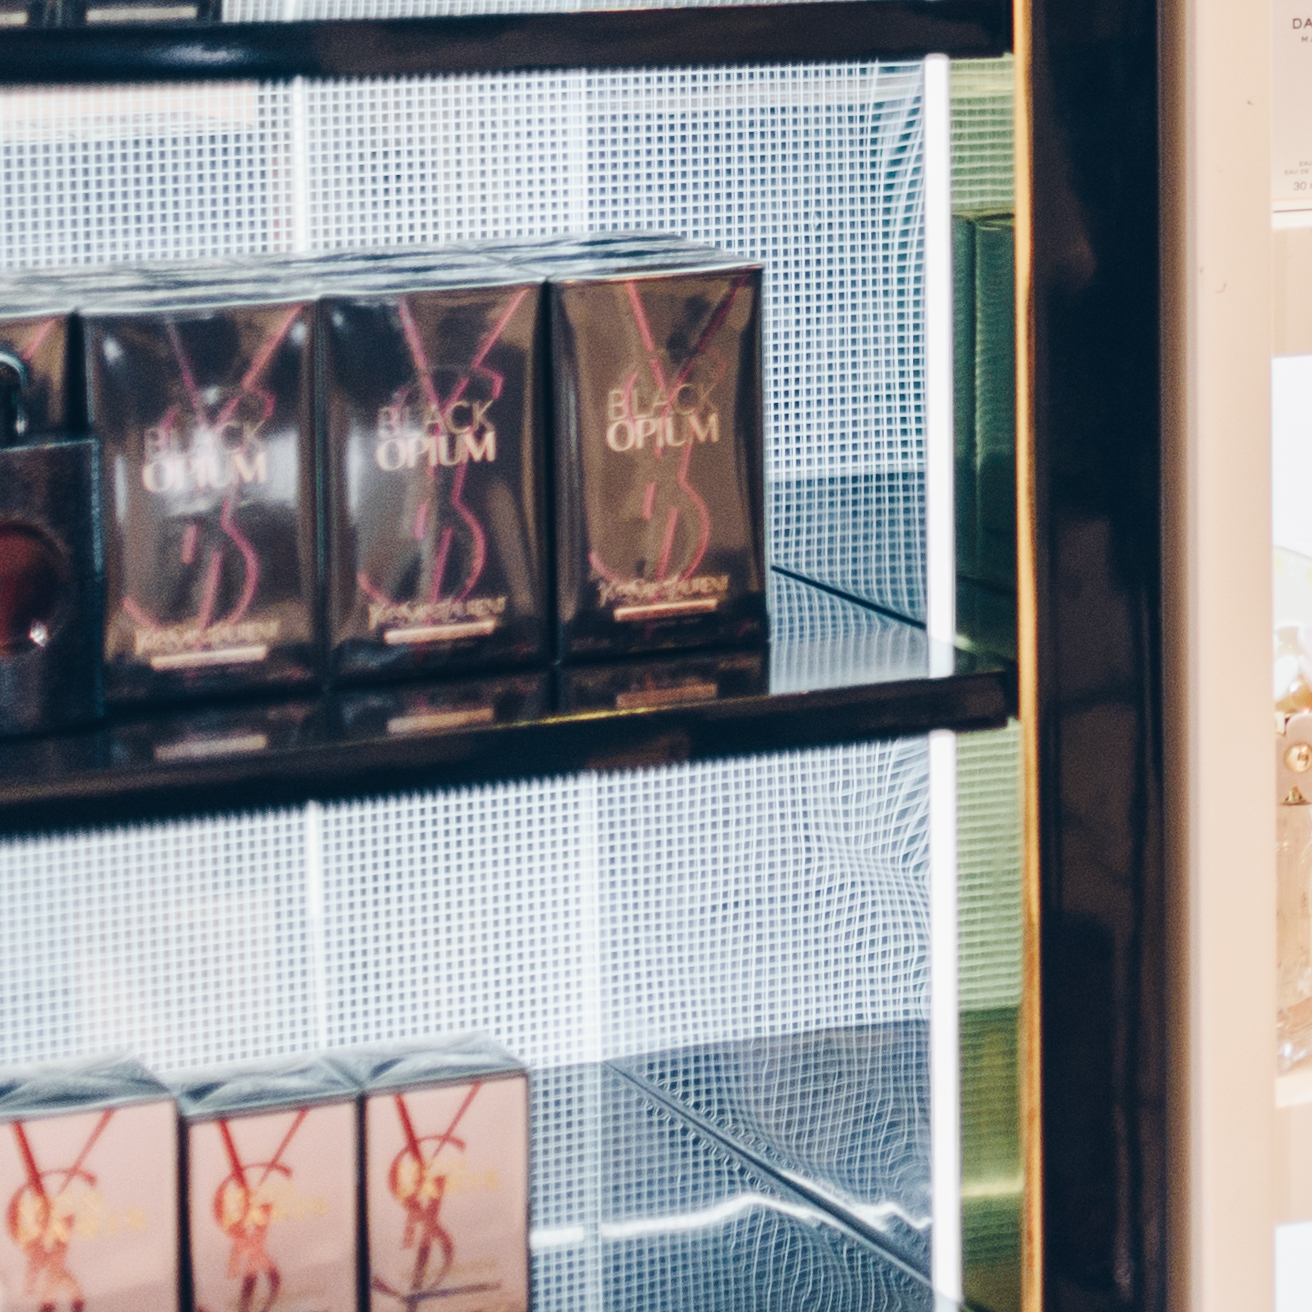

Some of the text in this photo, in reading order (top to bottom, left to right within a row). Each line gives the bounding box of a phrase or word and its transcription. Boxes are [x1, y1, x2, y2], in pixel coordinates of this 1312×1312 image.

[1292, 181, 1307, 191] 30
[607, 383, 721, 421] BLACK
[606, 411, 720, 452] OPIUM
[375, 431, 497, 472] OPIUM
